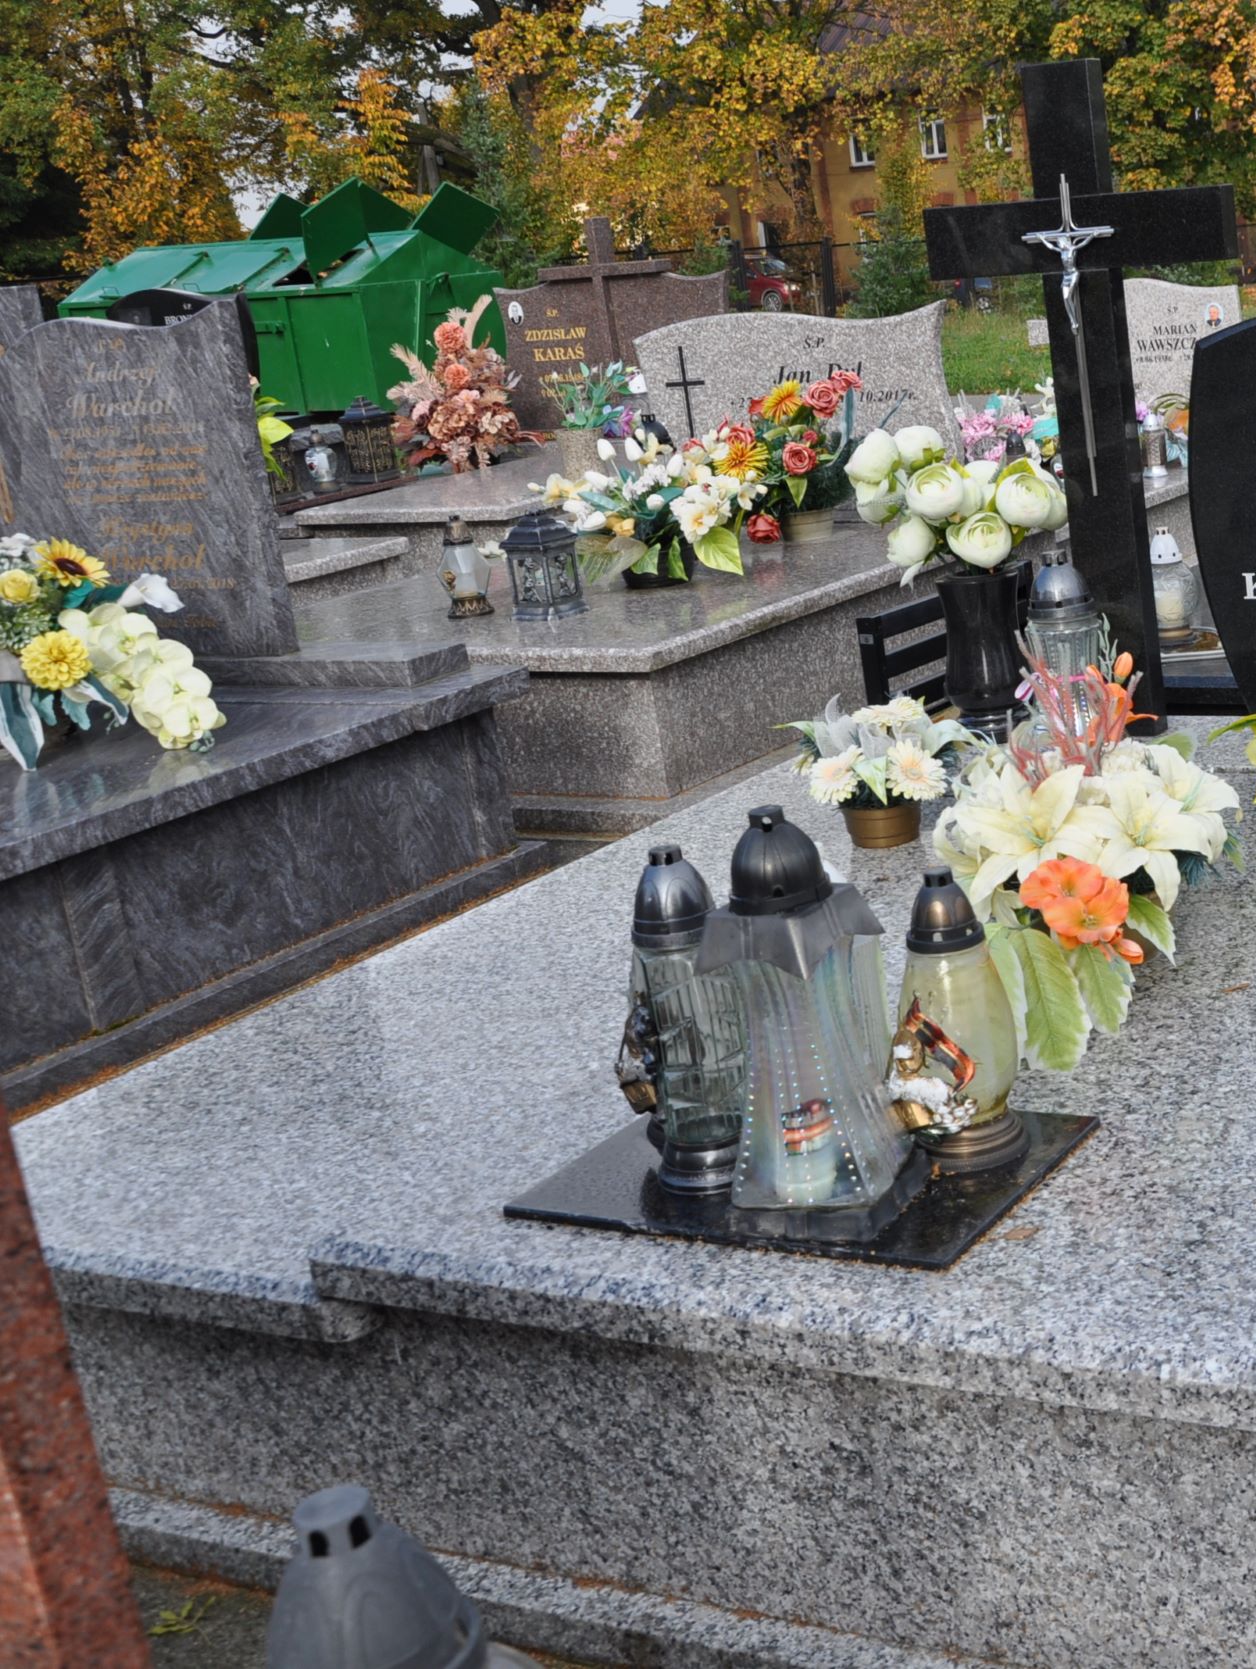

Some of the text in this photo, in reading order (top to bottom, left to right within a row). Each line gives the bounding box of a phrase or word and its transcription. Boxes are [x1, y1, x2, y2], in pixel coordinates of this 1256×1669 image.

[533, 343, 585, 362] KARAŚ
[1137, 337, 1197, 352] WAWSZCZ
[773, 365, 811, 385] Jan
[859, 388, 918, 403] 10.2017r.
